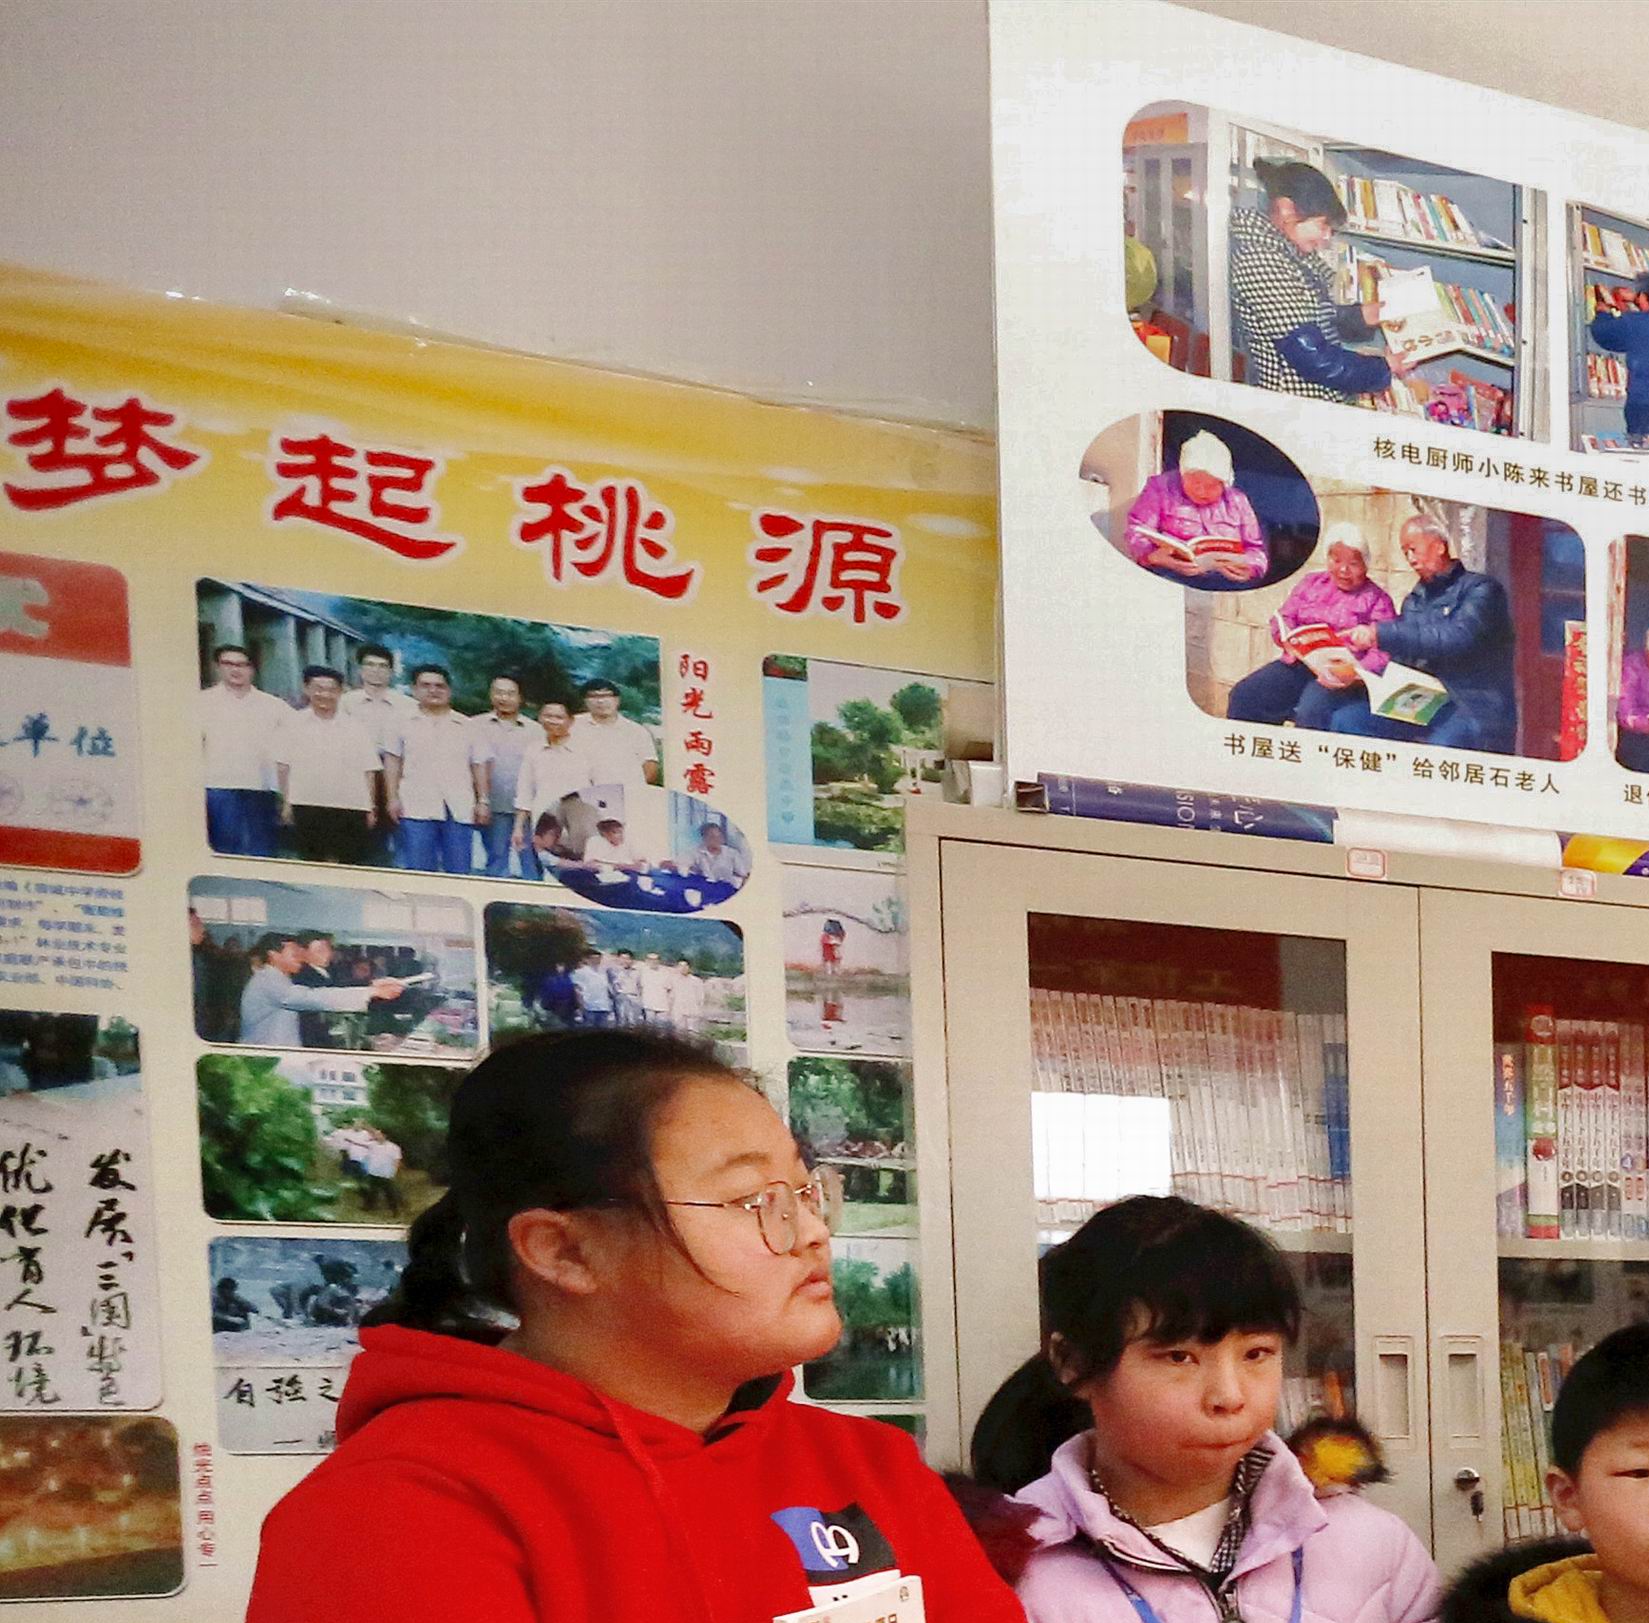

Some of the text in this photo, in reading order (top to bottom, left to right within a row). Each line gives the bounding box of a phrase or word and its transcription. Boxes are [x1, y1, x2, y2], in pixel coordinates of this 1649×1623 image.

[3, 387, 904, 624] 梦起桃源
[0, 712, 117, 757] 单位
[676, 651, 717, 797] 阳光雨露
